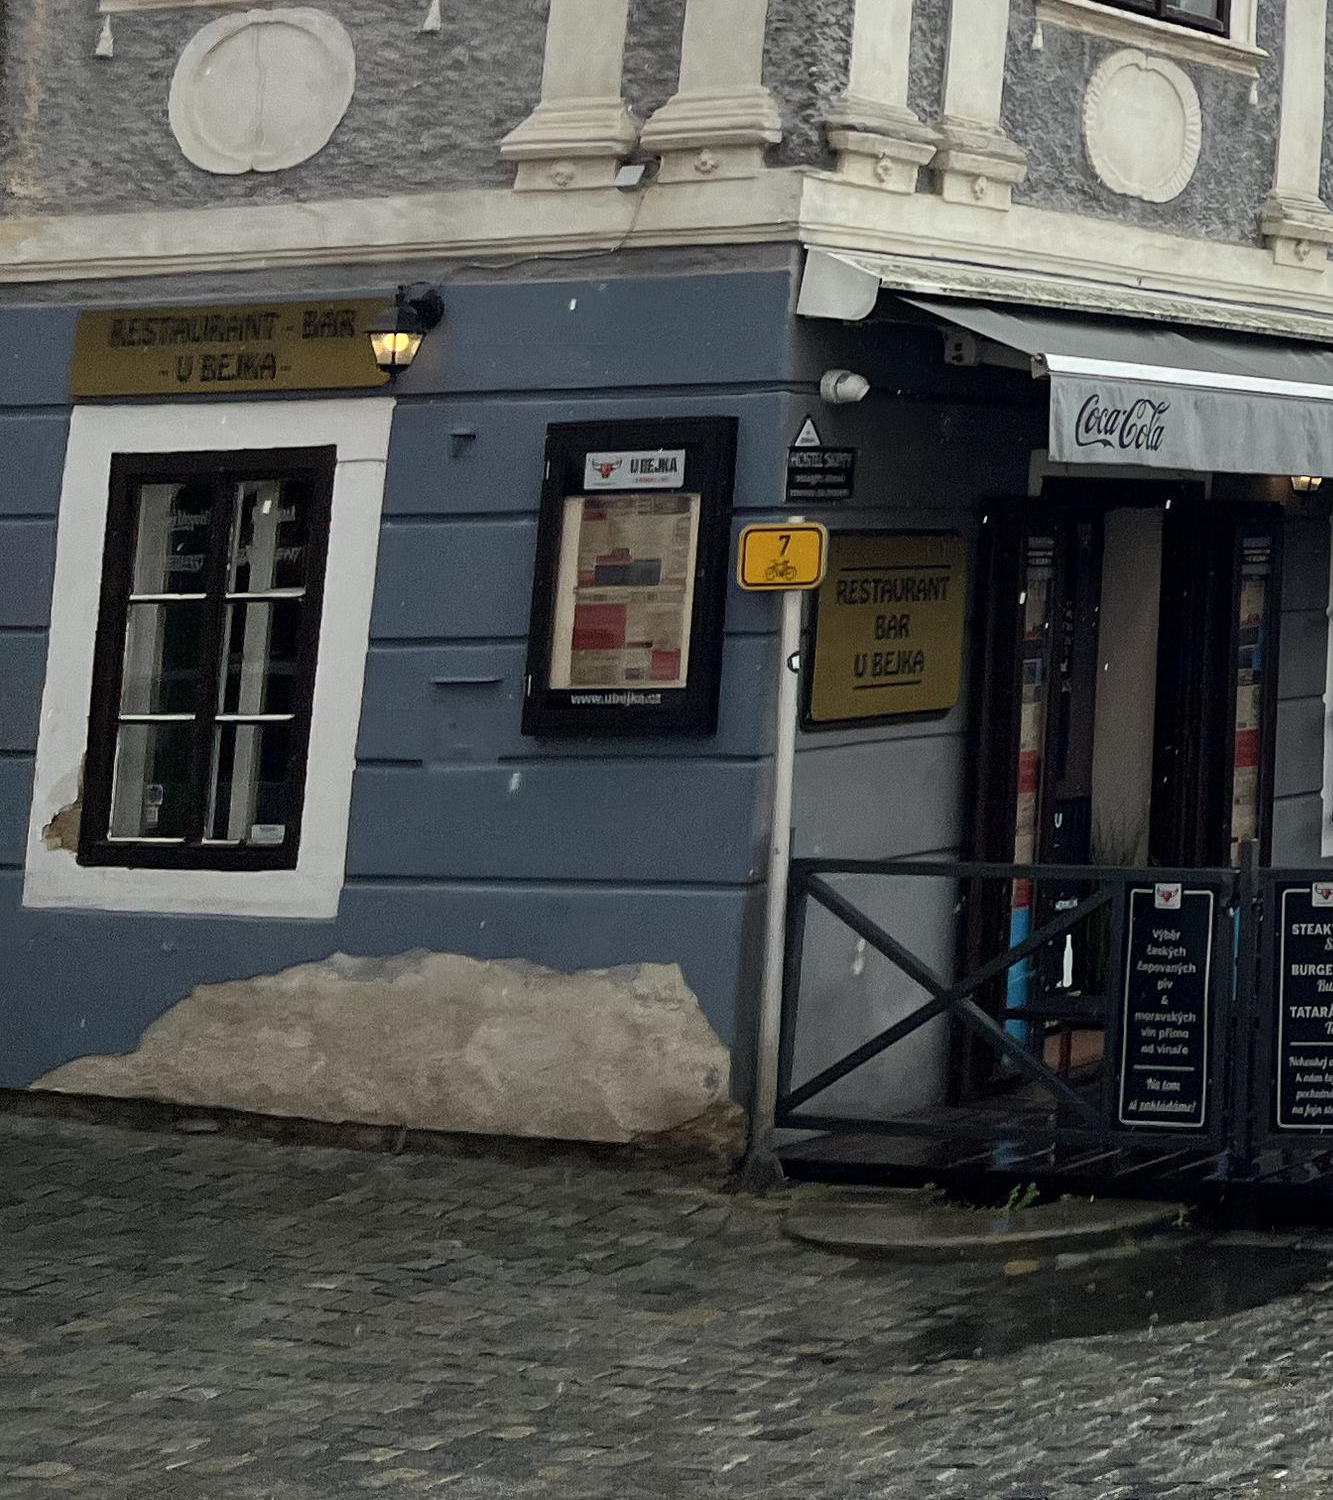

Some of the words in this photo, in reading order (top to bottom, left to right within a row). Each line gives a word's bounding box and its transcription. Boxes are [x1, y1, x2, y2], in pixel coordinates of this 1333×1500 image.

[109, 311, 281, 348] RESTAURANT
[302, 308, 356, 340] BAR
[174, 354, 193, 382] U
[1075, 394, 1171, 451] Coca-Cola
[778, 534, 792, 557] 7
[836, 575, 950, 605] RESTAURANT
[873, 613, 911, 641] BAR
[853, 653, 868, 679] U
[871, 649, 926, 678] BEJKA
